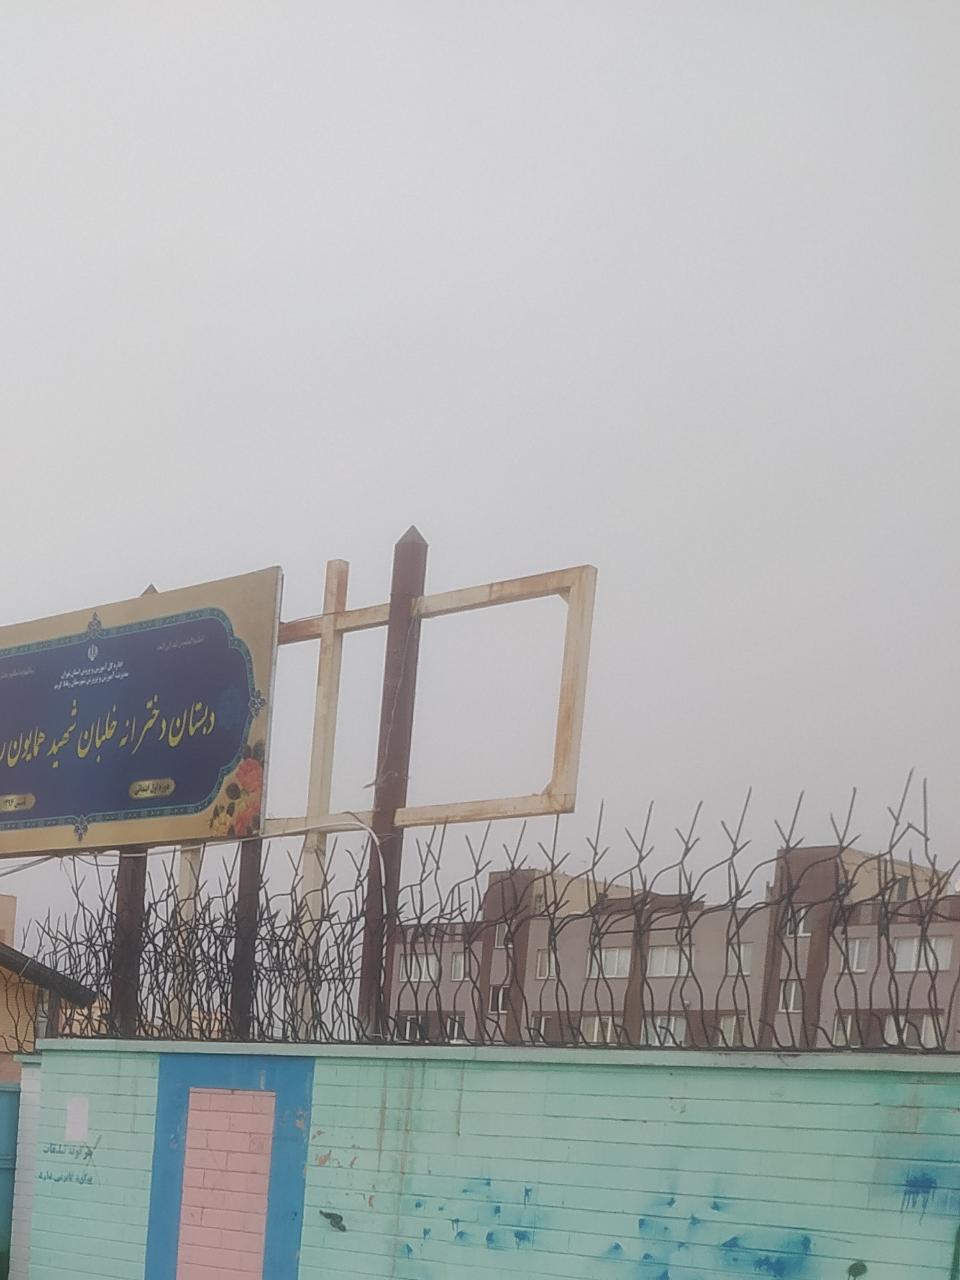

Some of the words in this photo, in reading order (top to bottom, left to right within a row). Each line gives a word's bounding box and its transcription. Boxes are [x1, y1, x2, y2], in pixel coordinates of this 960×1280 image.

[6, 727, 46, 768] همایون
[47, 698, 78, 769] شهید
[77, 704, 118, 764] خلبان
[119, 694, 167, 755] دخترانه
[168, 701, 216, 747] دبستان
